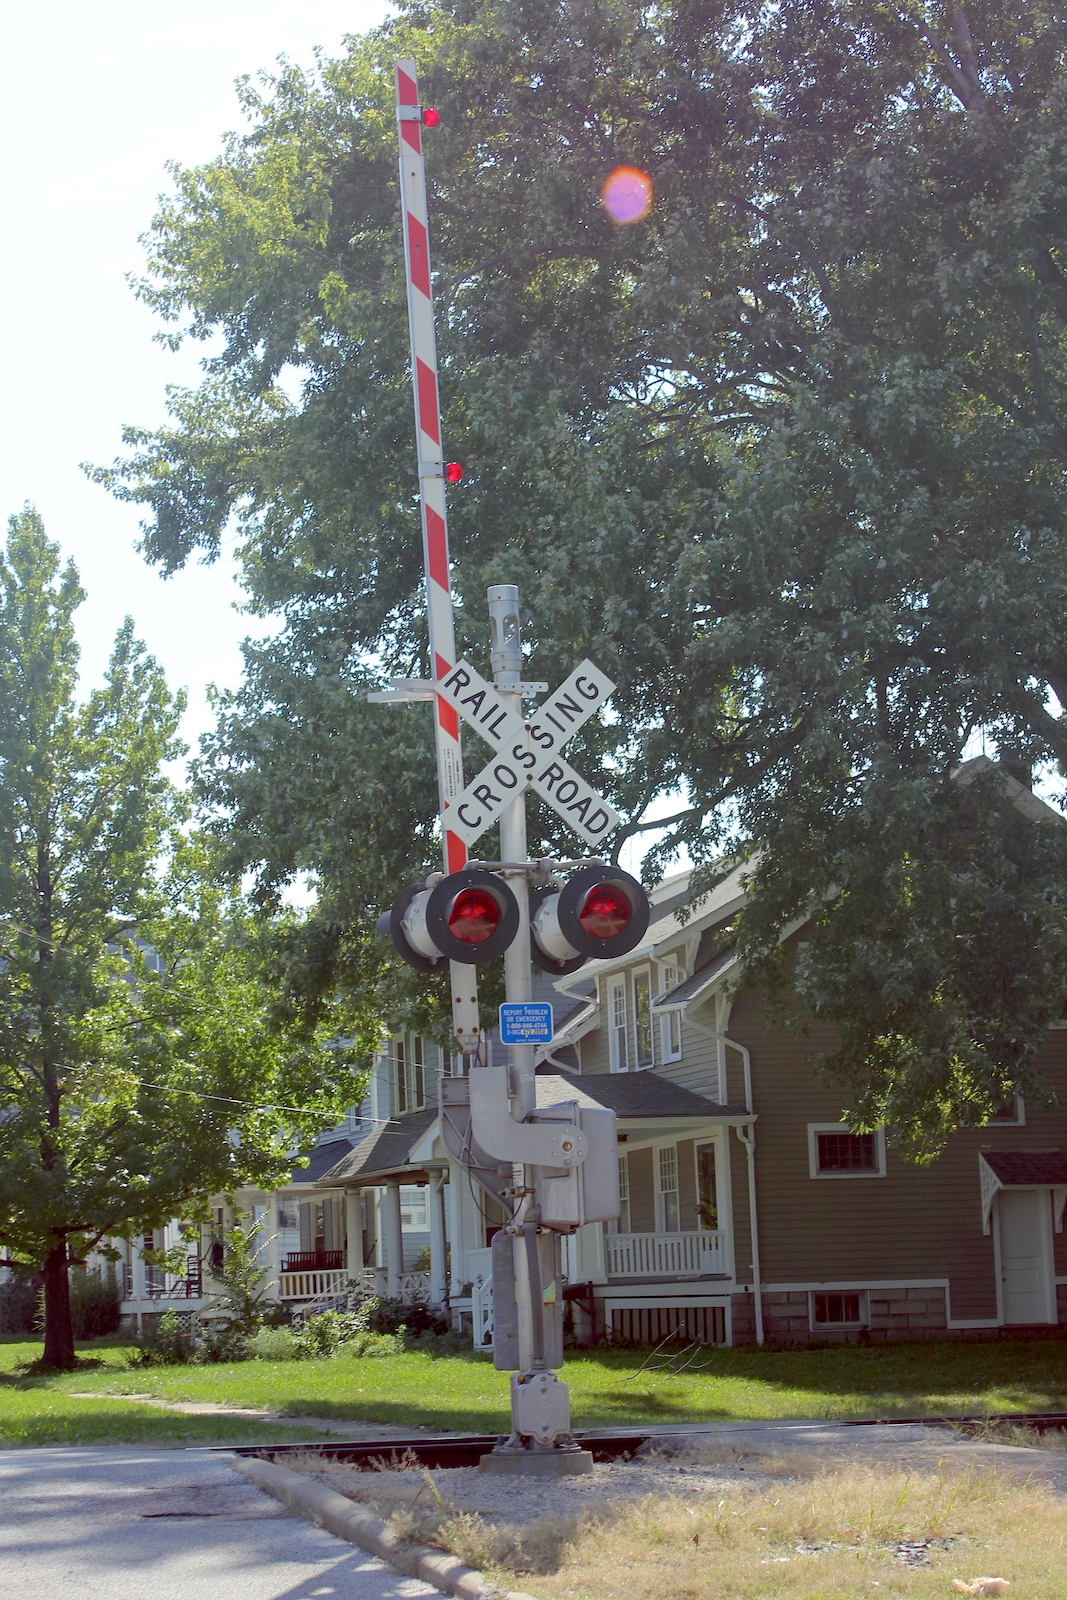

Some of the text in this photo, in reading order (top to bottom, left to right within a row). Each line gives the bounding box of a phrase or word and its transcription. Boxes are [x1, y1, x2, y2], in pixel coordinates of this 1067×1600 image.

[444, 667, 508, 741] RAIL
[537, 761, 609, 834] ROAD
[457, 676, 599, 828] CROSSING
